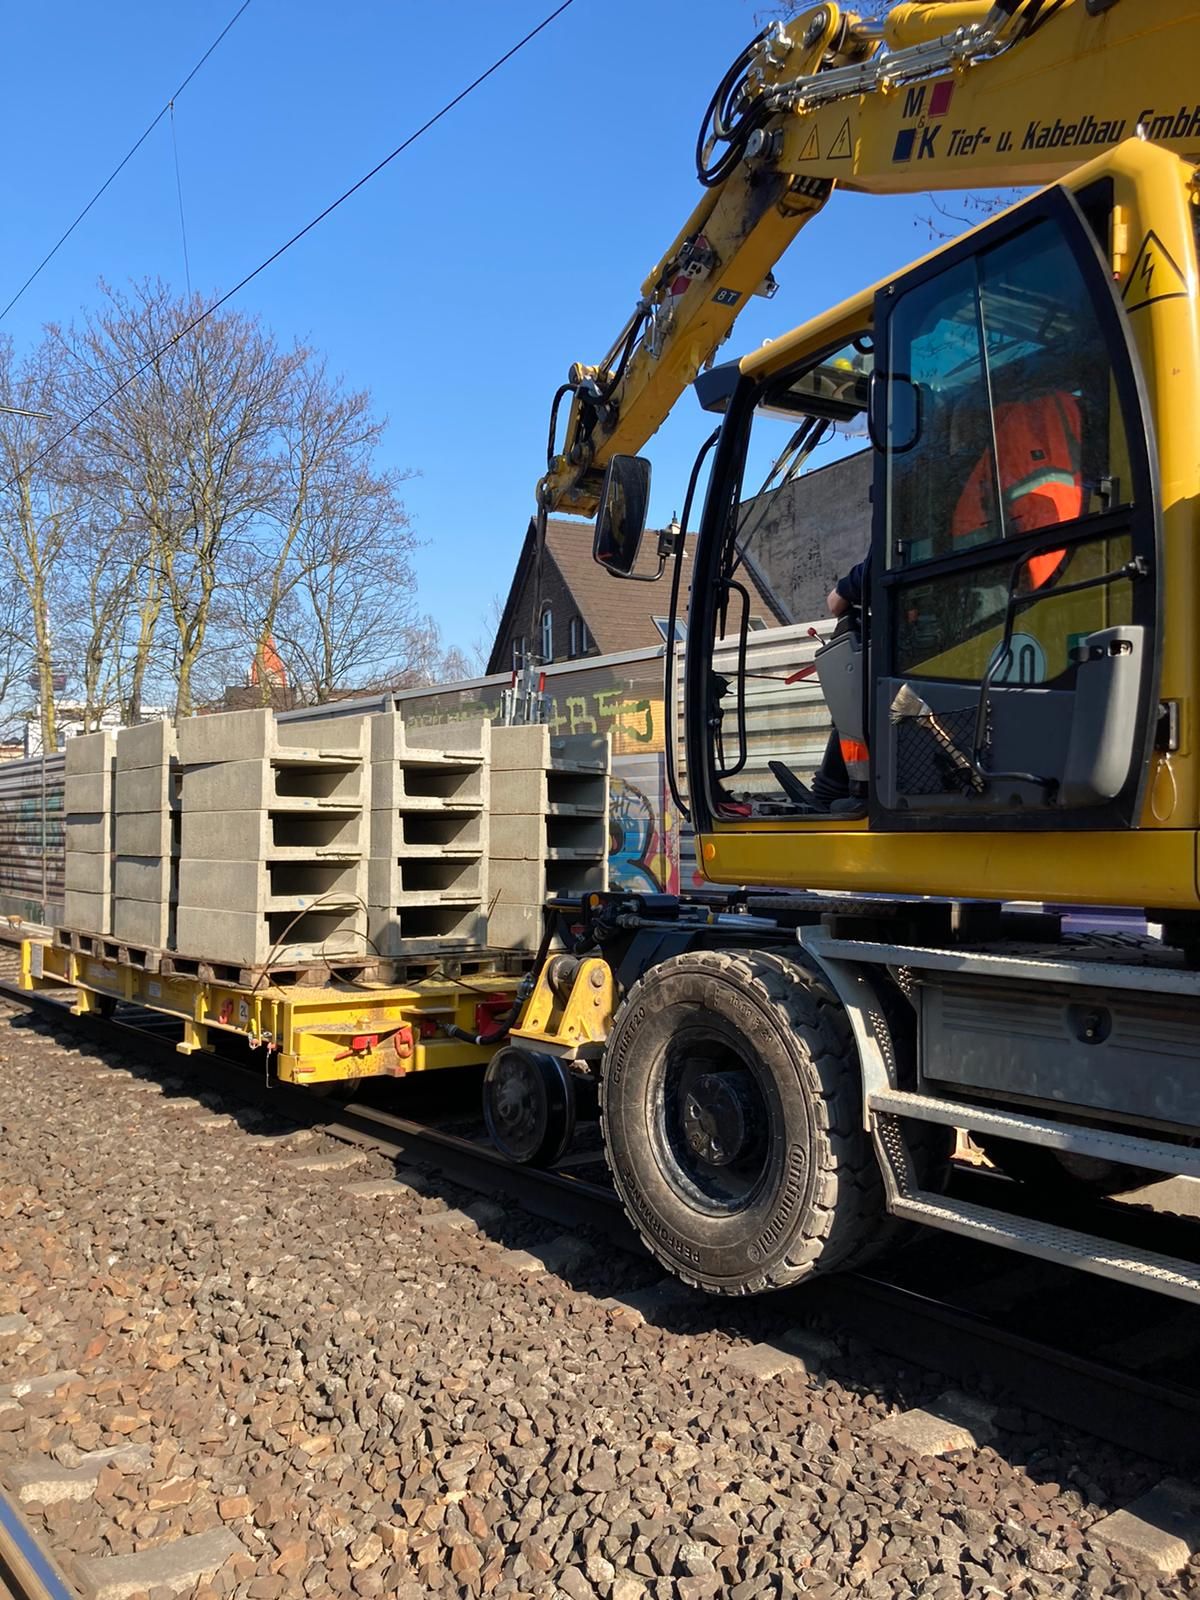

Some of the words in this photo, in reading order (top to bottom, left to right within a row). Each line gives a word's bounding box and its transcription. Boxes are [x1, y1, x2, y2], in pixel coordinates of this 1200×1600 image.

[902, 85, 927, 118] M
[917, 124, 942, 159] K
[946, 126, 992, 157] Tief-
[995, 131, 1013, 152] u.
[1020, 115, 1126, 150] Kabelbau
[623, 1166, 701, 1264] PERFORMANCE
[757, 1142, 807, 1255] Continental
